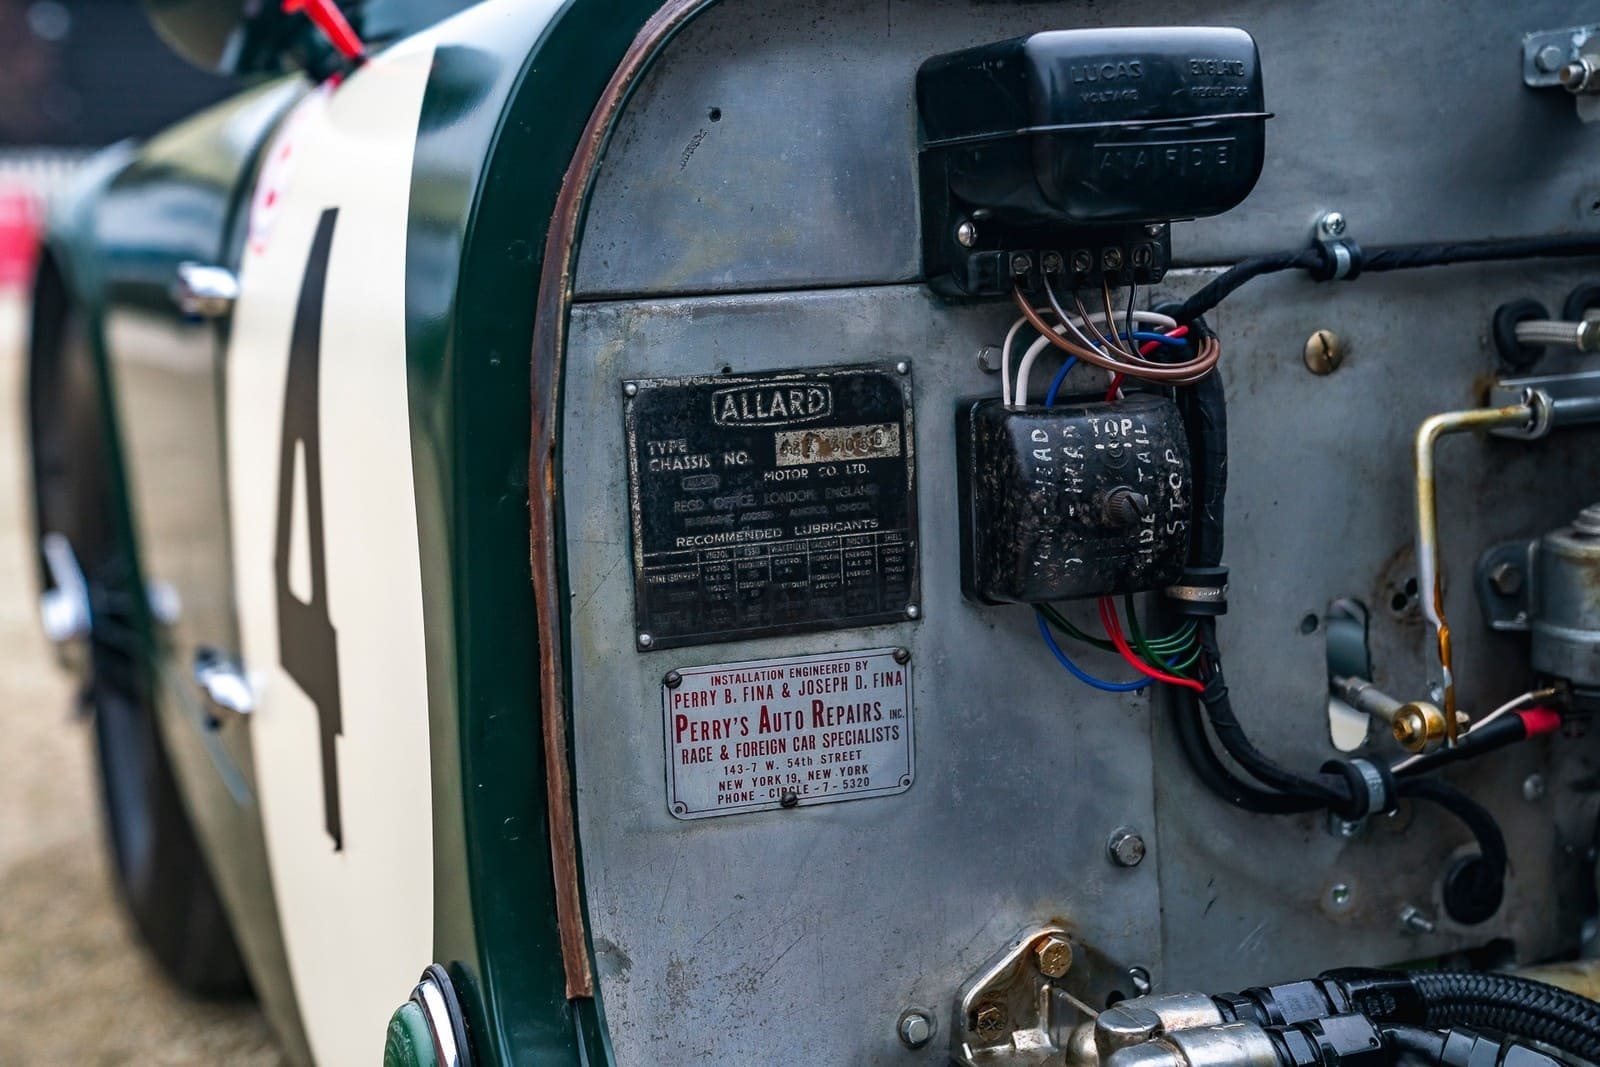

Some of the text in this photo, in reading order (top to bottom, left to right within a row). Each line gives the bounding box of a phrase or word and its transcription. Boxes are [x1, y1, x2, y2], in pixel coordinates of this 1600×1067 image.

[1071, 59, 1143, 83] LUCAS
[1190, 58, 1244, 76] ENGLAND
[720, 387, 825, 421] ALLARD
[1087, 418, 1133, 440] TOP
[647, 438, 688, 456] TYPE
[650, 453, 711, 472] CHASSIS
[764, 468, 809, 482] MOTOR
[274, 206, 344, 852] 4
[676, 518, 879, 548] RECOMMENDED LUBRICANTS
[711, 660, 869, 687] INSTALLATION ENGINEERED BY
[674, 671, 903, 709] PERRY B. FINA & JOSEPH D. FINA
[675, 699, 905, 744] PERRY'S AUTO REPAIRS INC.
[682, 724, 900, 765] RACE & FOREIGN CAR SPECIALISTS
[723, 750, 863, 776] 143-7 W. 54th STREET
[717, 791, 755, 805] PHONE
[842, 776, 870, 790] 5320
[718, 779, 744, 792] NEW
[751, 775, 782, 788] YORK
[807, 768, 833, 781] NEW
[840, 764, 869, 778] YORK
